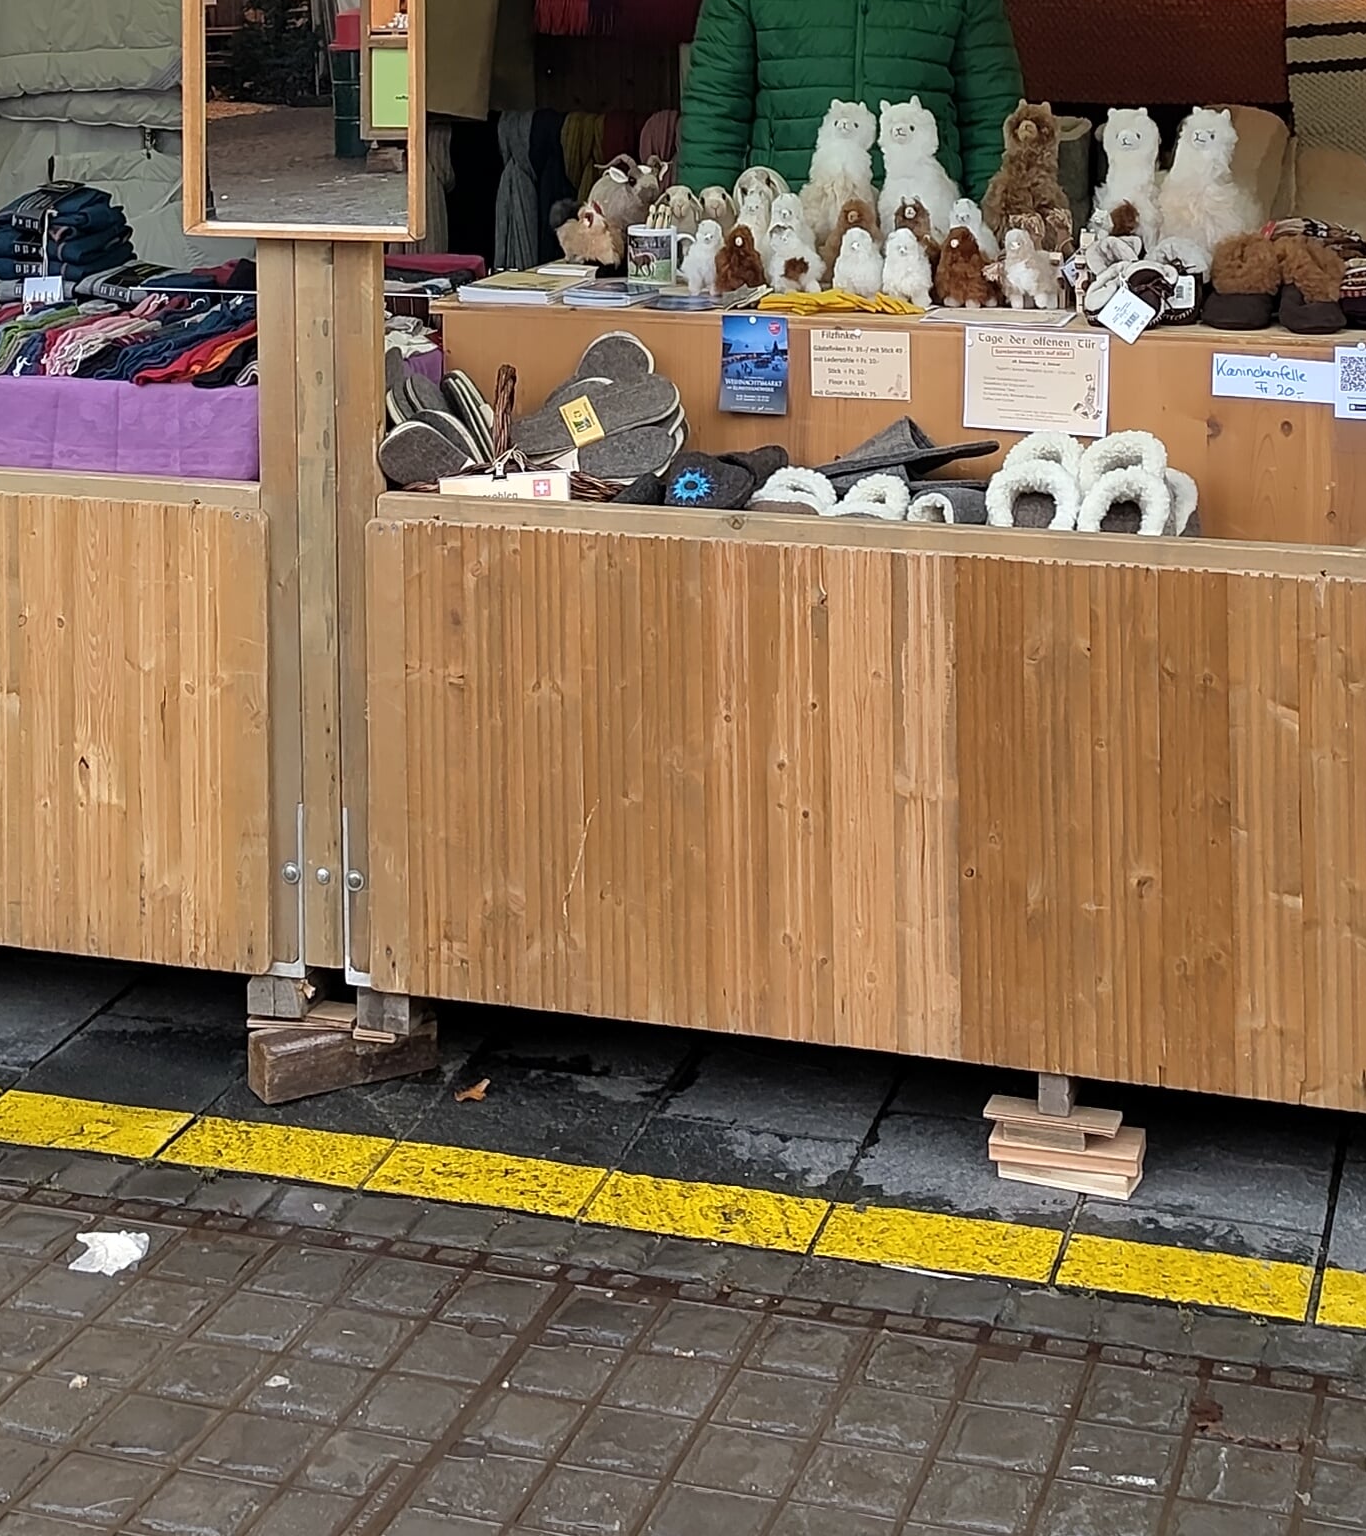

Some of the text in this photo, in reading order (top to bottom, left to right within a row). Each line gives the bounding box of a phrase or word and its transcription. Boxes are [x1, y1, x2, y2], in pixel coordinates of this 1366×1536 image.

[821, 330, 862, 340] Filzfinken
[978, 332, 1096, 349] Tage der offenen Tür
[824, 356, 855, 364] Ledersohle
[1216, 358, 1308, 383] Kaninchenfelle
